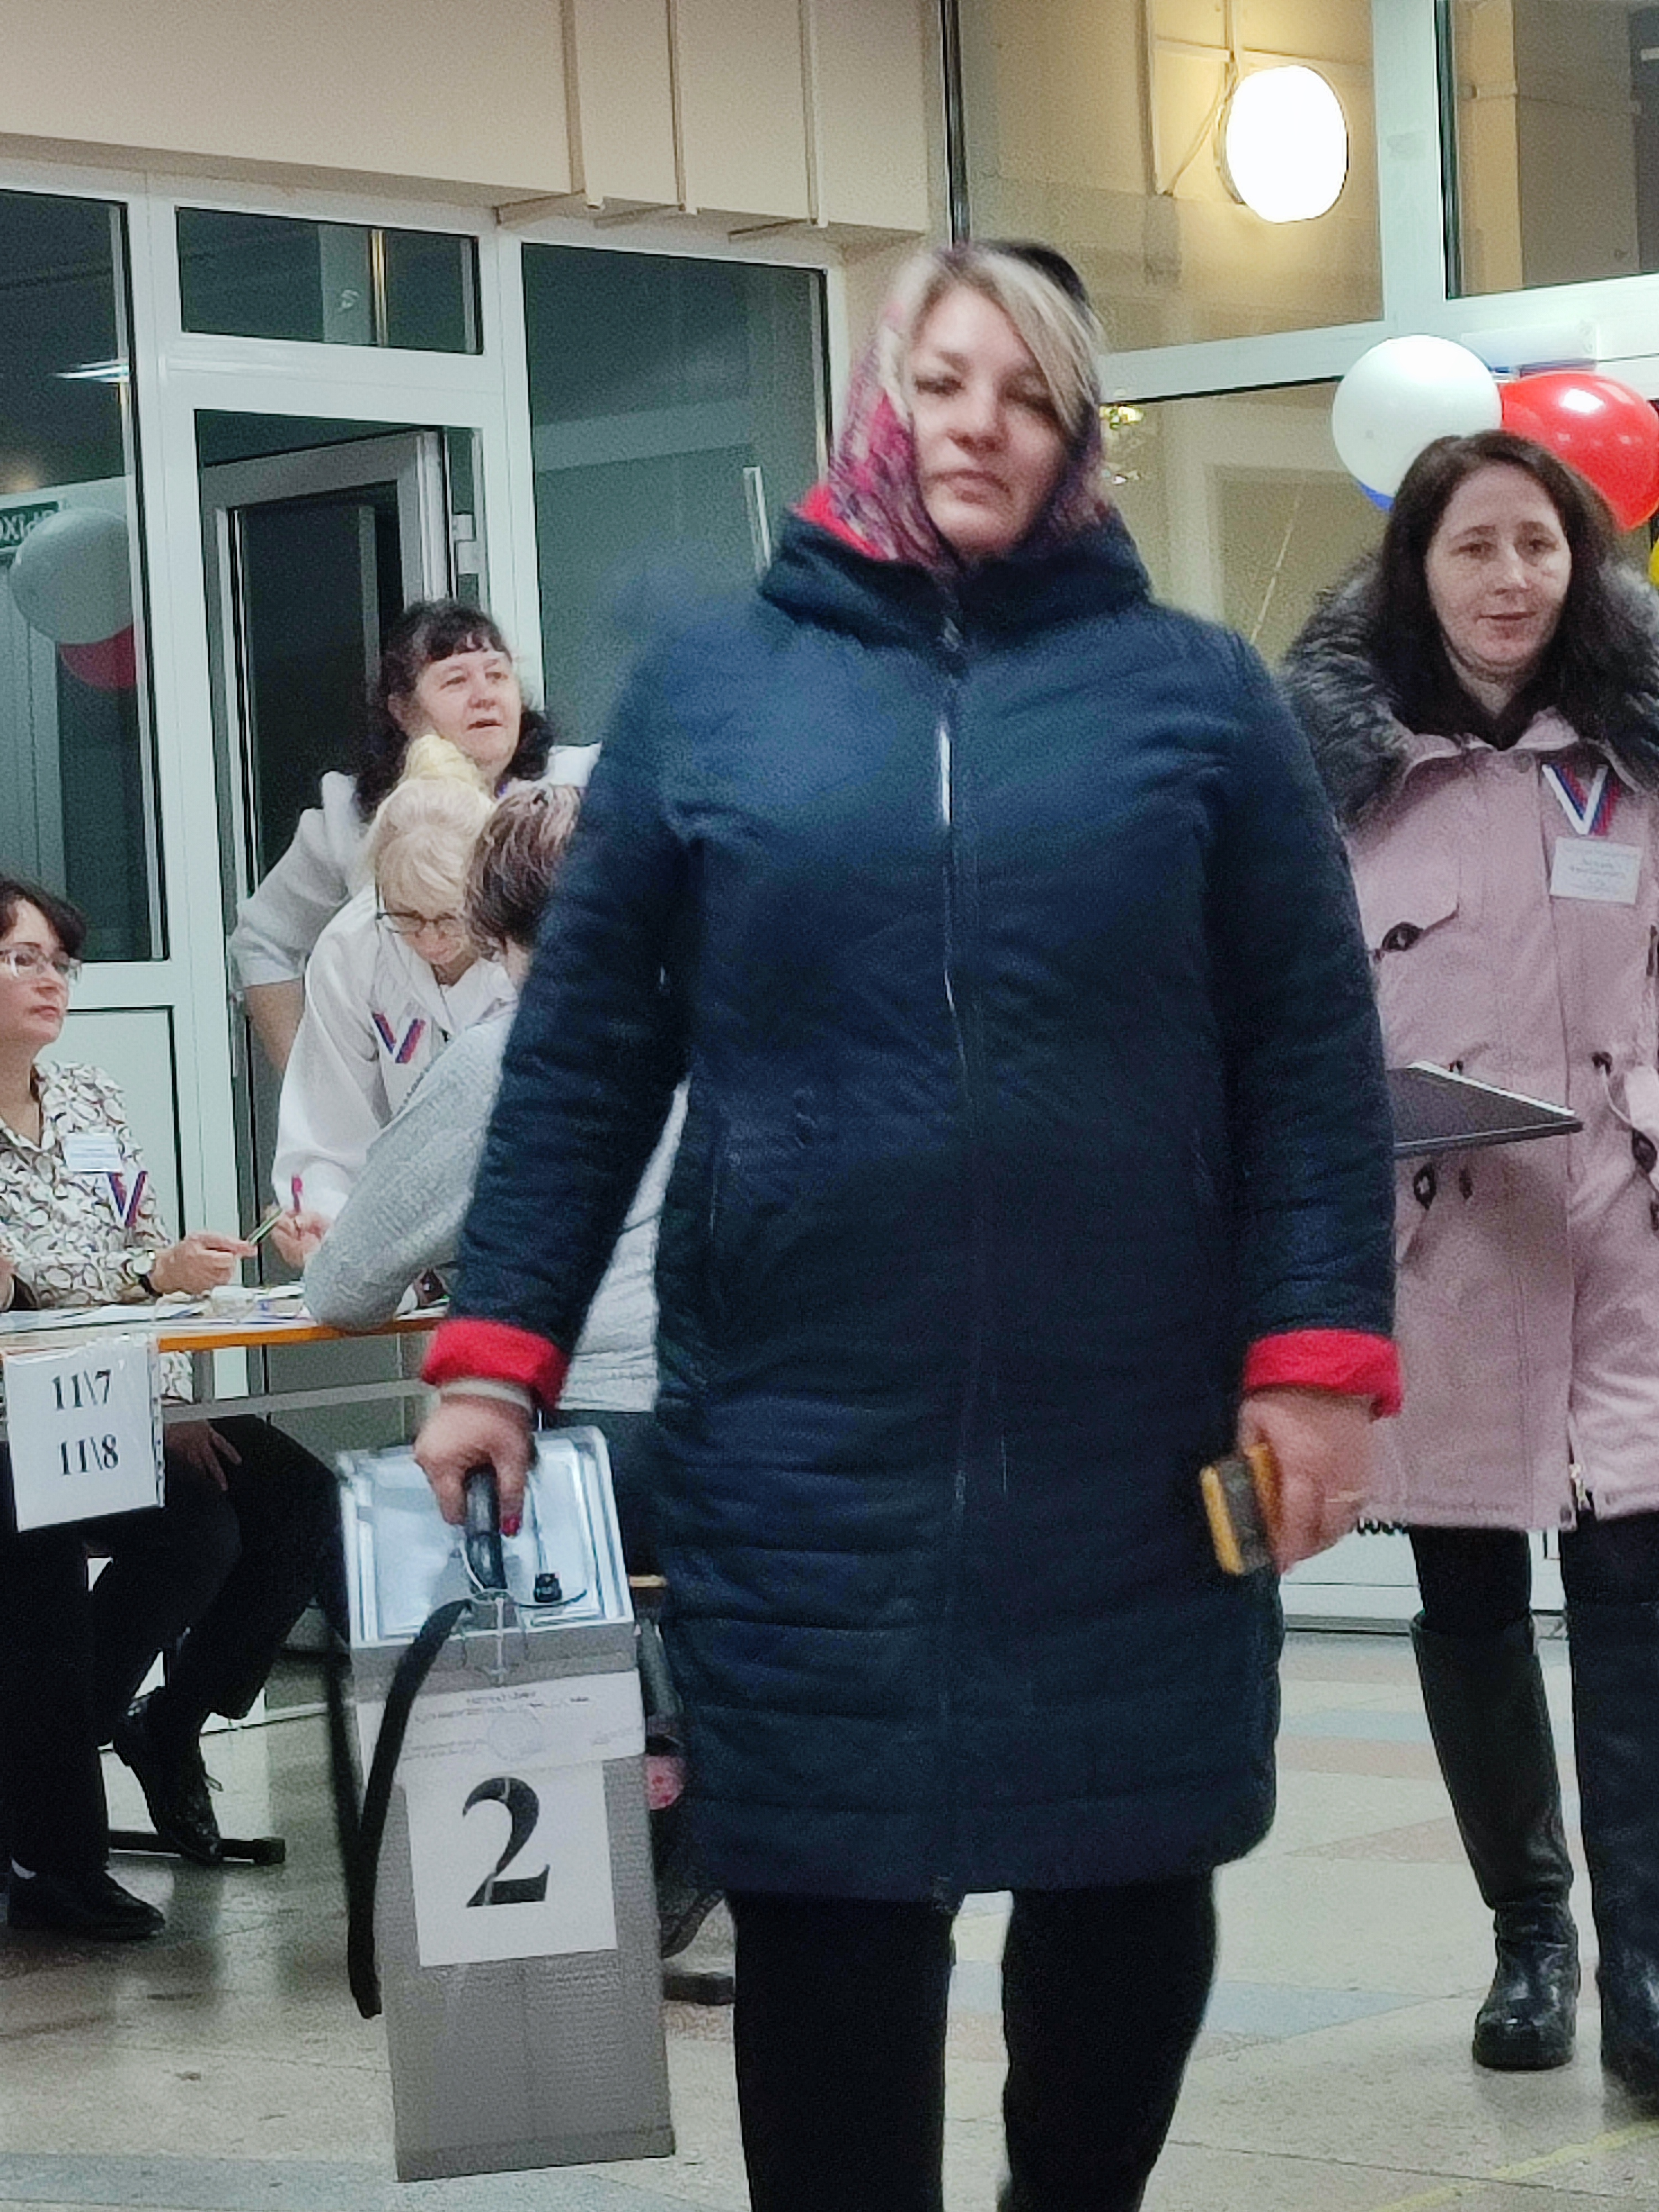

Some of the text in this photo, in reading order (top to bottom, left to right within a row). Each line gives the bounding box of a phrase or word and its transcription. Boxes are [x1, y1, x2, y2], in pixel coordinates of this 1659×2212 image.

[53, 1369, 112, 1410] 11\7
[60, 1434, 119, 1475] 11\8
[462, 1776, 551, 1908] 2
